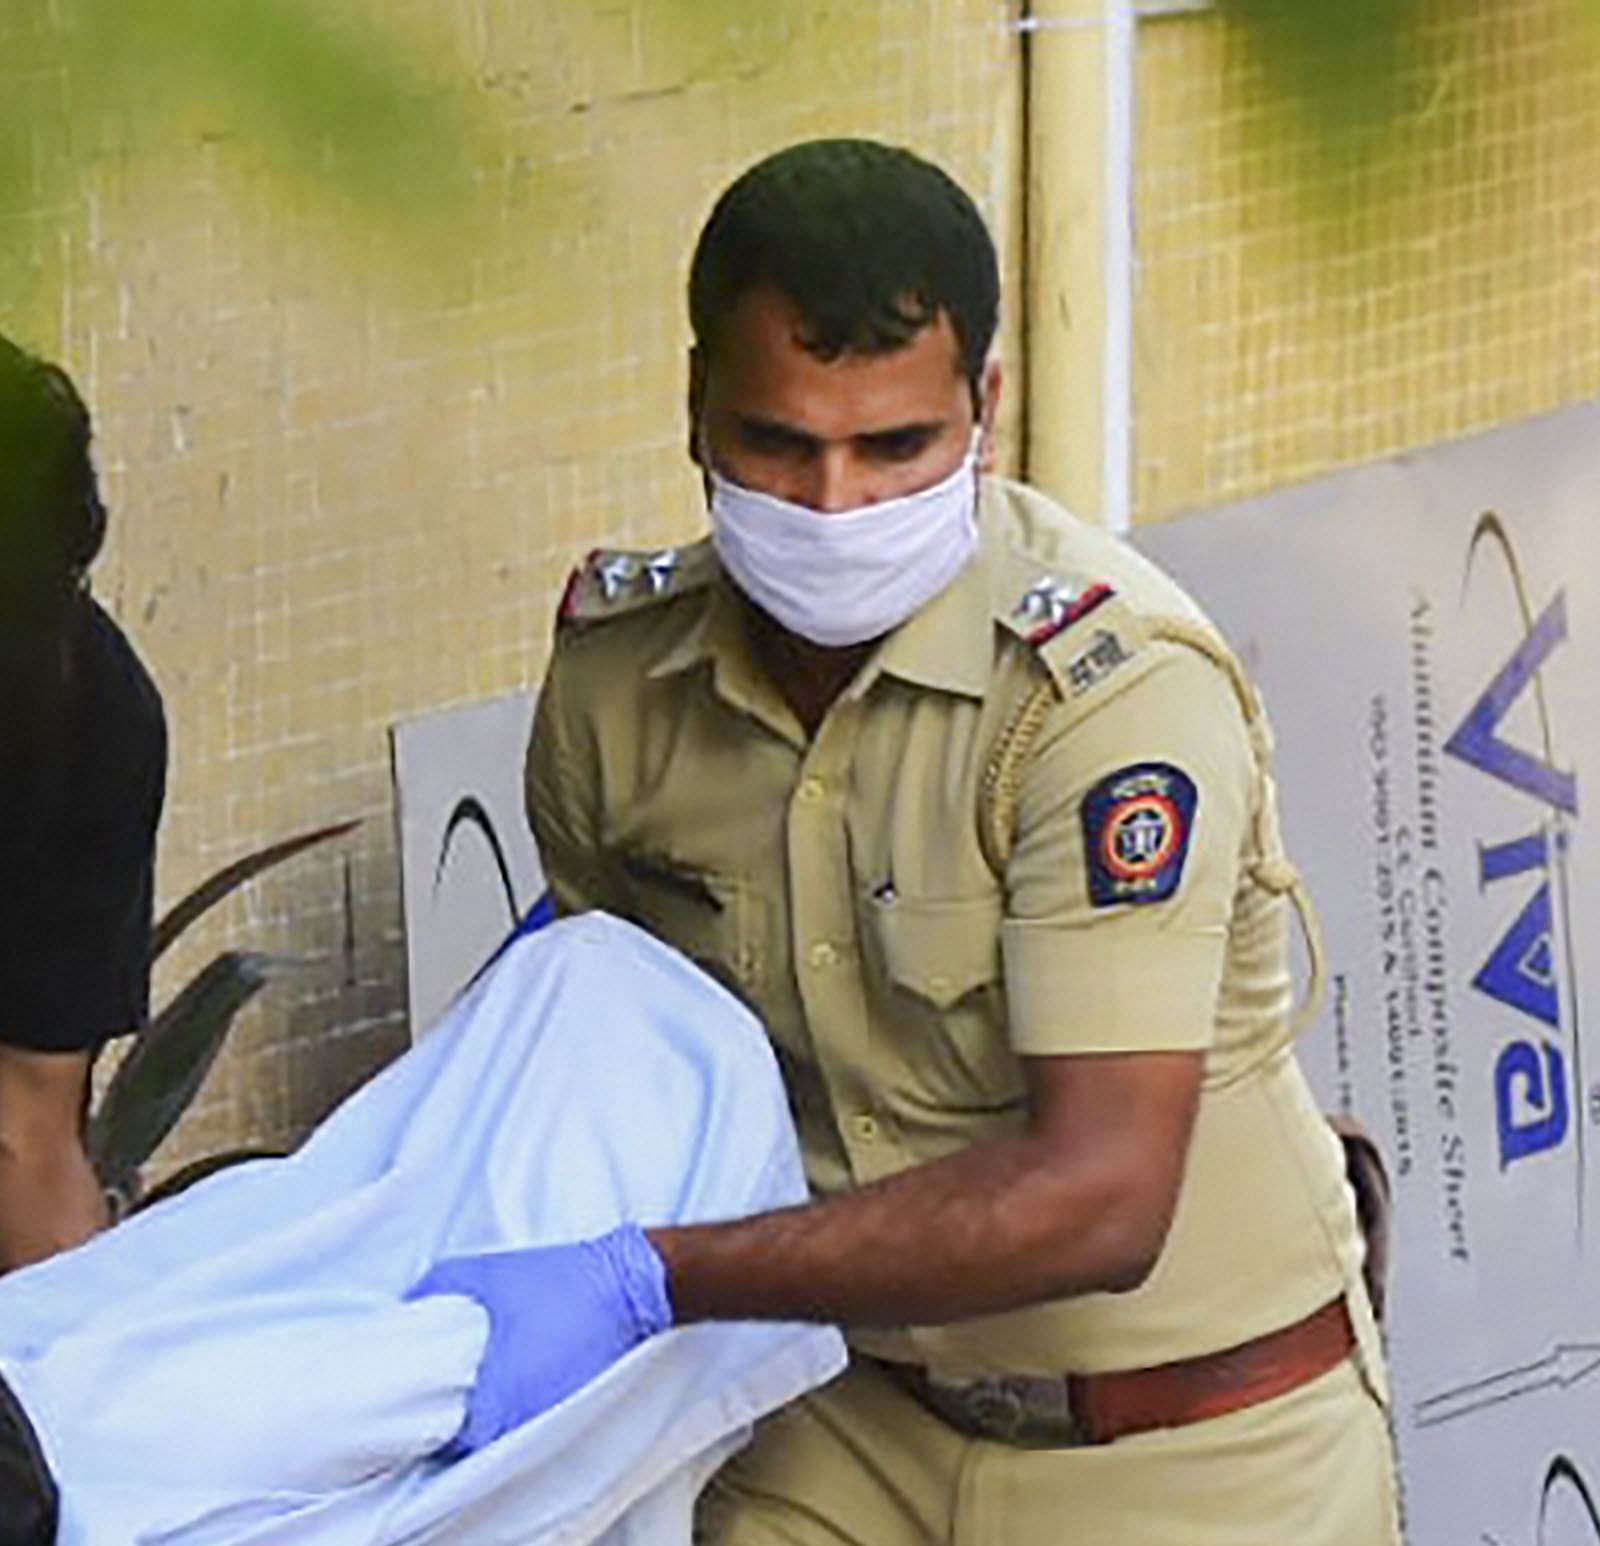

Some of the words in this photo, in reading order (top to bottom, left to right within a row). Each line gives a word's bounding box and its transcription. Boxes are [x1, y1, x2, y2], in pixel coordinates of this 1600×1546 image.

[1408, 585, 1438, 849] Aluminium
[1422, 867, 1459, 1119] Composite
[1441, 584, 1579, 1173] Viva
[1442, 1132, 1470, 1261] Sheet
